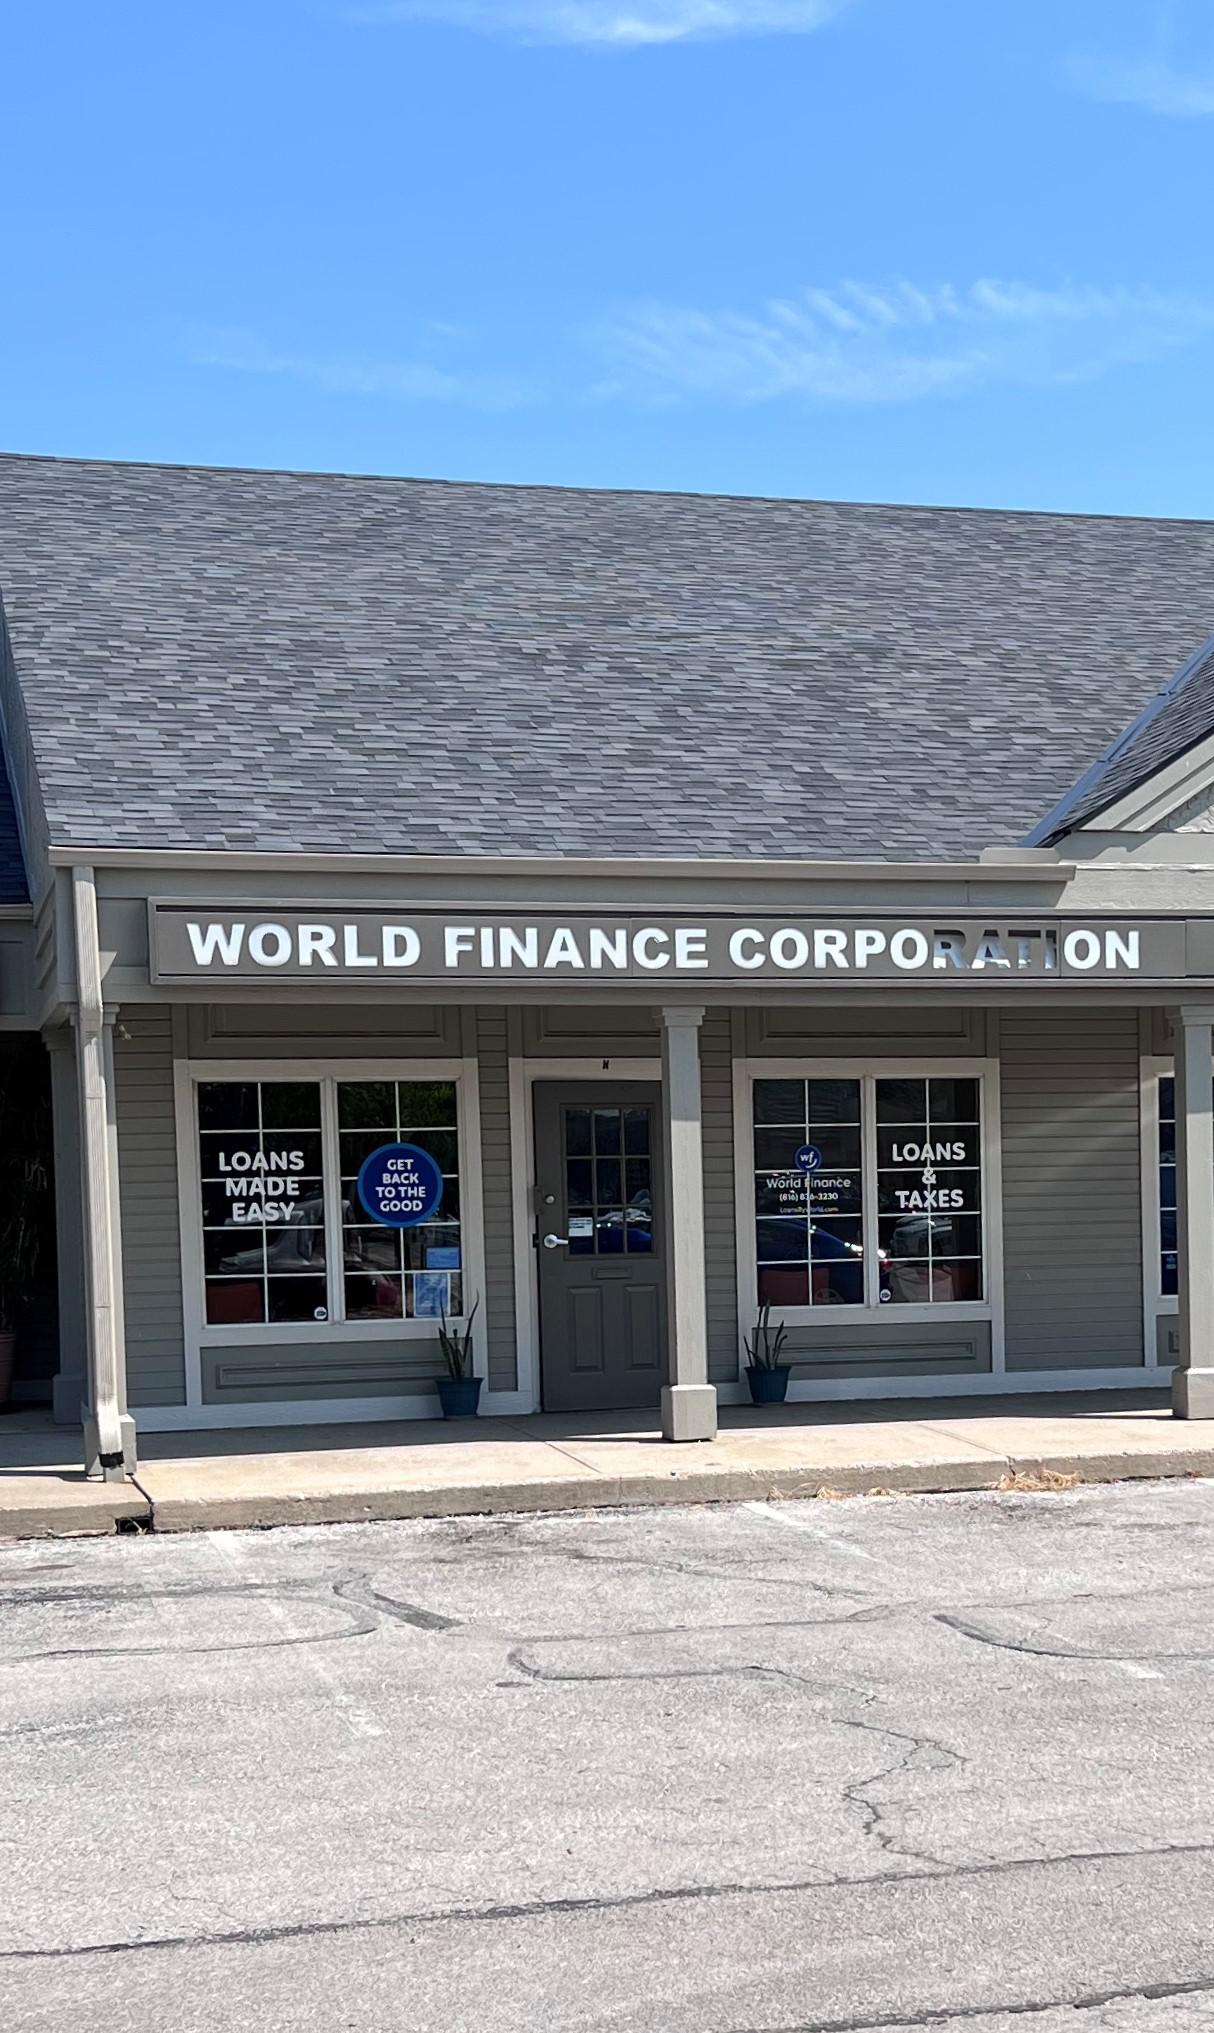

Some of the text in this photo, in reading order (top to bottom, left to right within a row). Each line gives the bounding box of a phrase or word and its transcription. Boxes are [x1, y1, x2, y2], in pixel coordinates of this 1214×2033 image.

[187, 923, 1140, 970] WORLD FINANCE CORPORATION
[892, 1142, 965, 1161] LOANS
[219, 1151, 304, 1171] LOANS
[388, 1159, 414, 1170] GET
[383, 1173, 419, 1184] BACK
[766, 1179, 851, 1188] World Finance
[922, 1167, 937, 1184] &
[226, 1177, 300, 1196] MADE
[375, 1187, 426, 1198] TO THE
[380, 1200, 422, 1211] GOOD
[779, 1193, 798, 1202] (816)
[895, 1190, 964, 1209] TAXES
[233, 1202, 295, 1222] EASY
